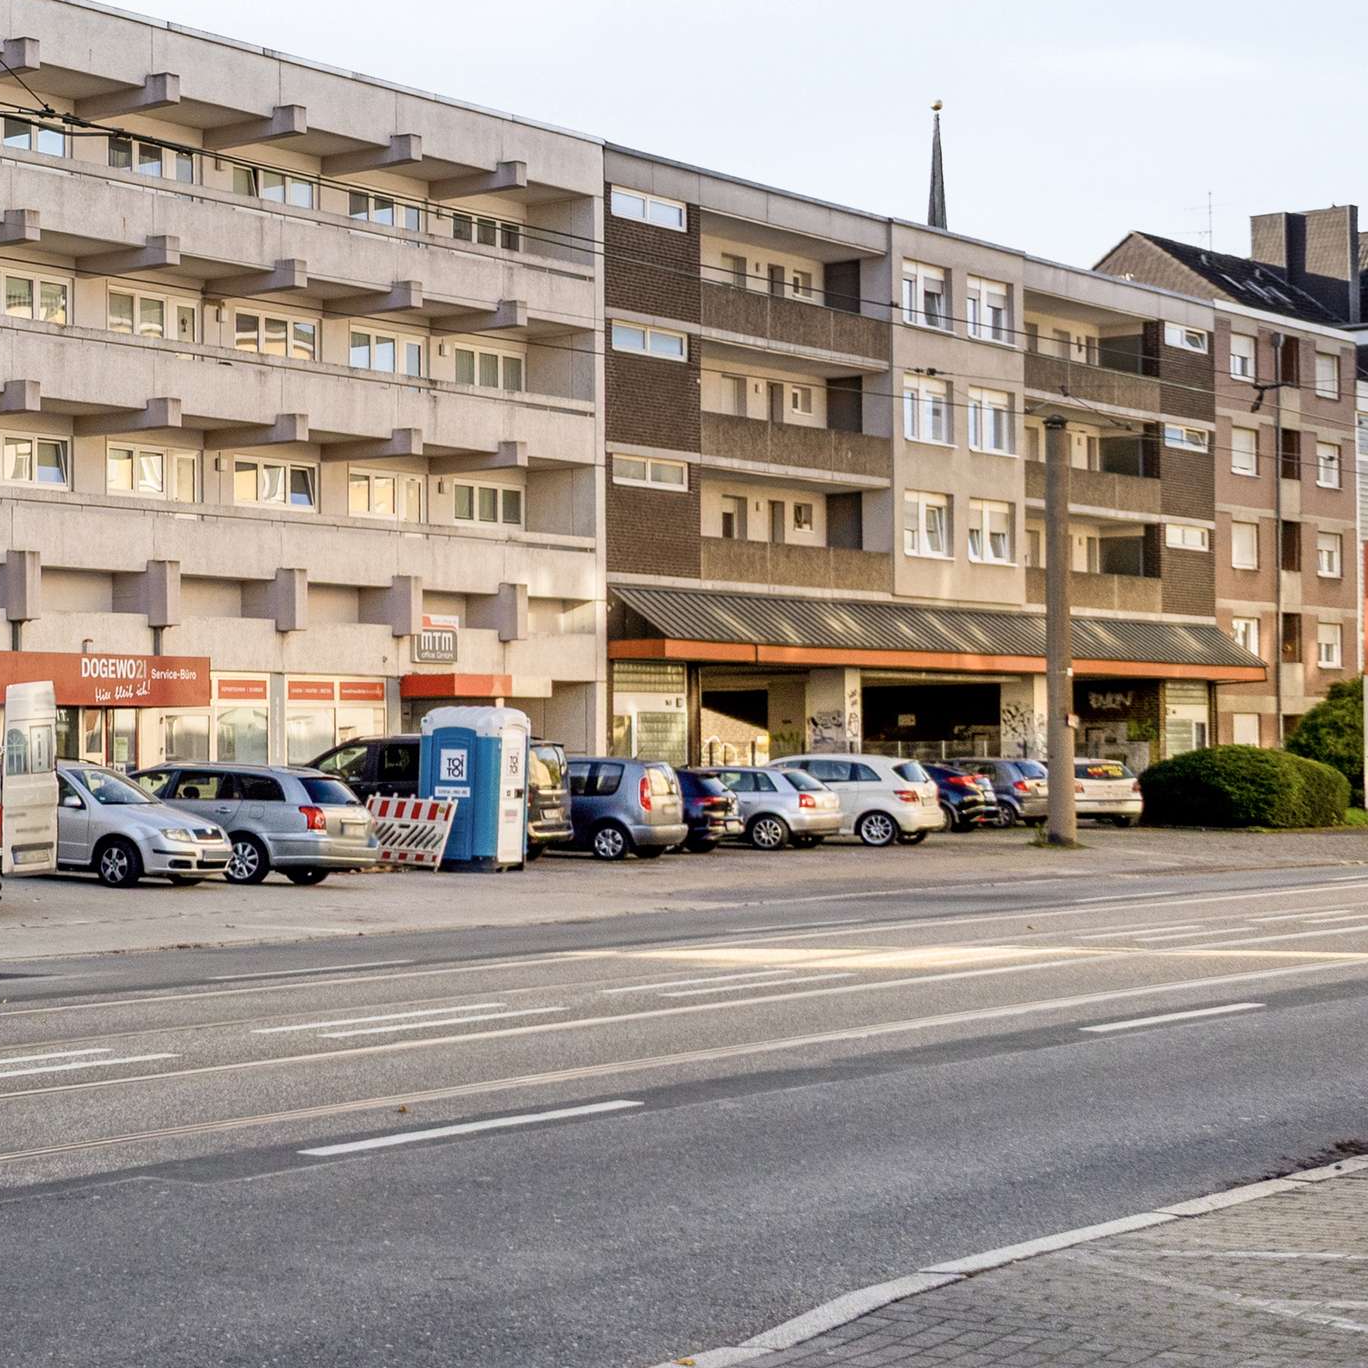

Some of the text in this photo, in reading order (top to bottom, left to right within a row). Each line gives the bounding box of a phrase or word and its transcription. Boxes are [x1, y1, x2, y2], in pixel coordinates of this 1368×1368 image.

[81, 658, 197, 680] DOGEWO21 Service-Büro
[95, 679, 151, 702] Hier bleib ich!
